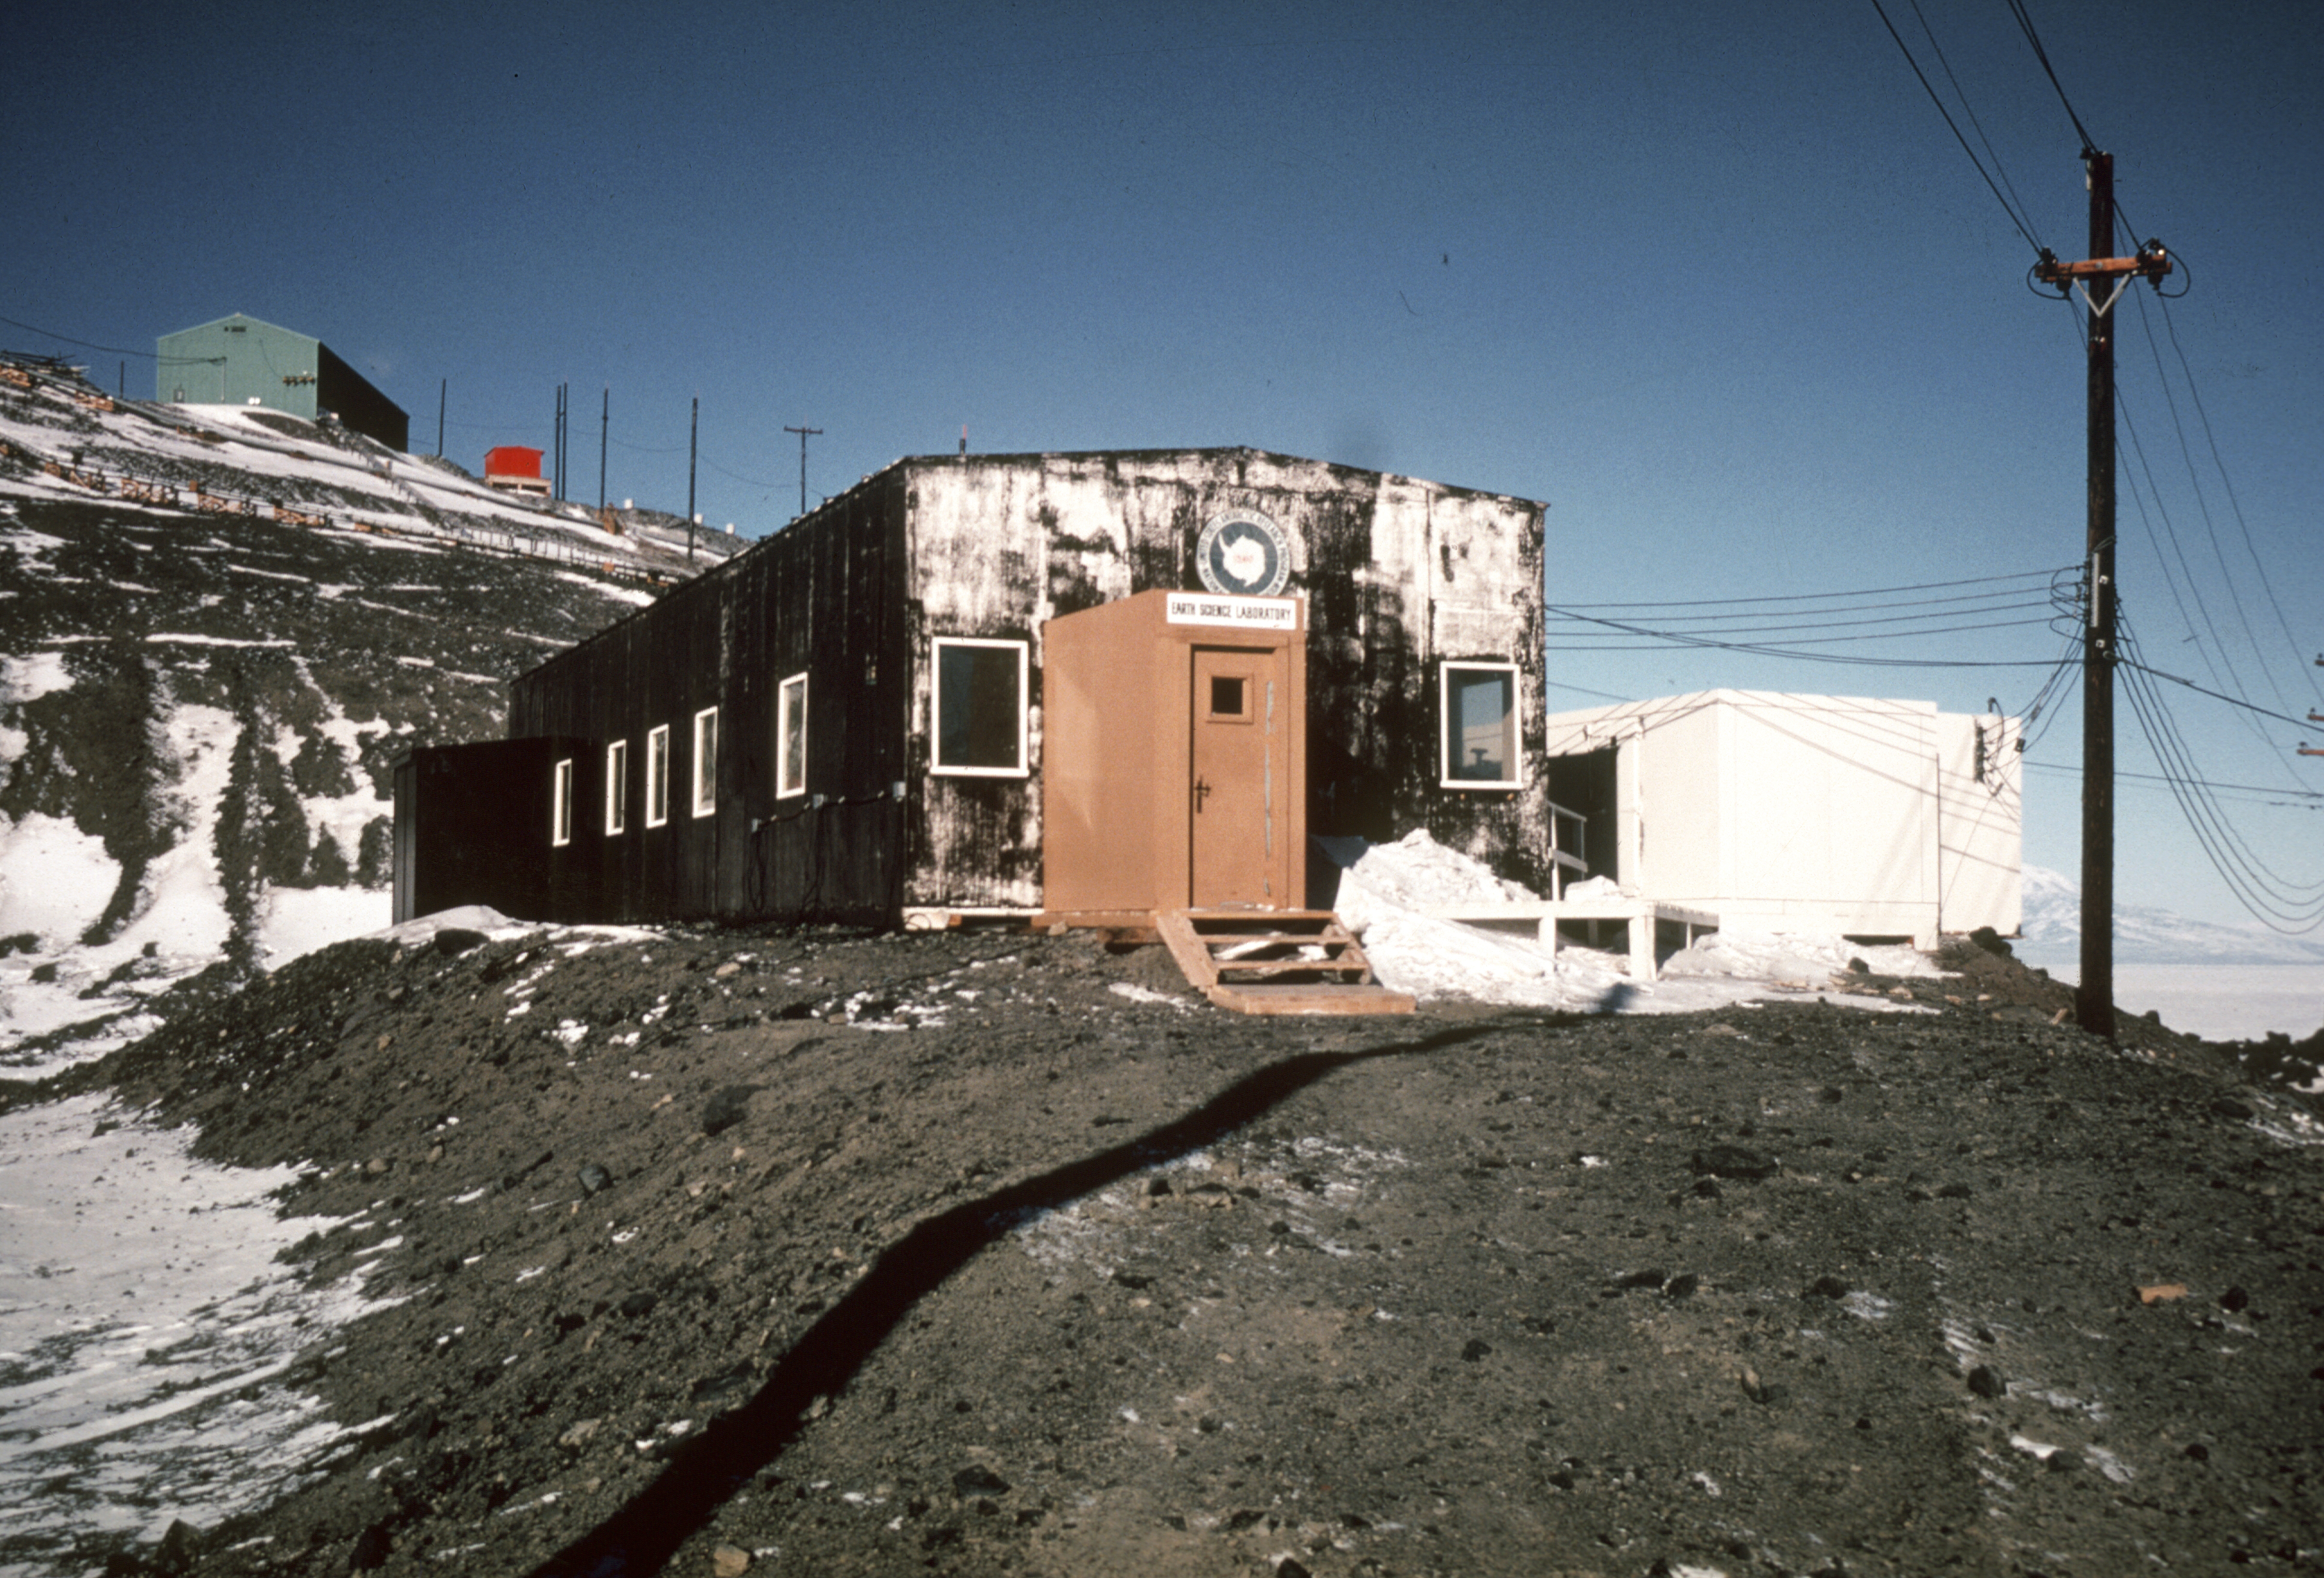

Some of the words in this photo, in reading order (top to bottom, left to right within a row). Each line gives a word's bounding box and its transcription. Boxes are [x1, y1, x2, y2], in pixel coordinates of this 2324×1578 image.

[1172, 602, 1195, 615] EARTH
[1200, 603, 1231, 618] SCIENCE
[1236, 606, 1291, 621] LABORATORY
